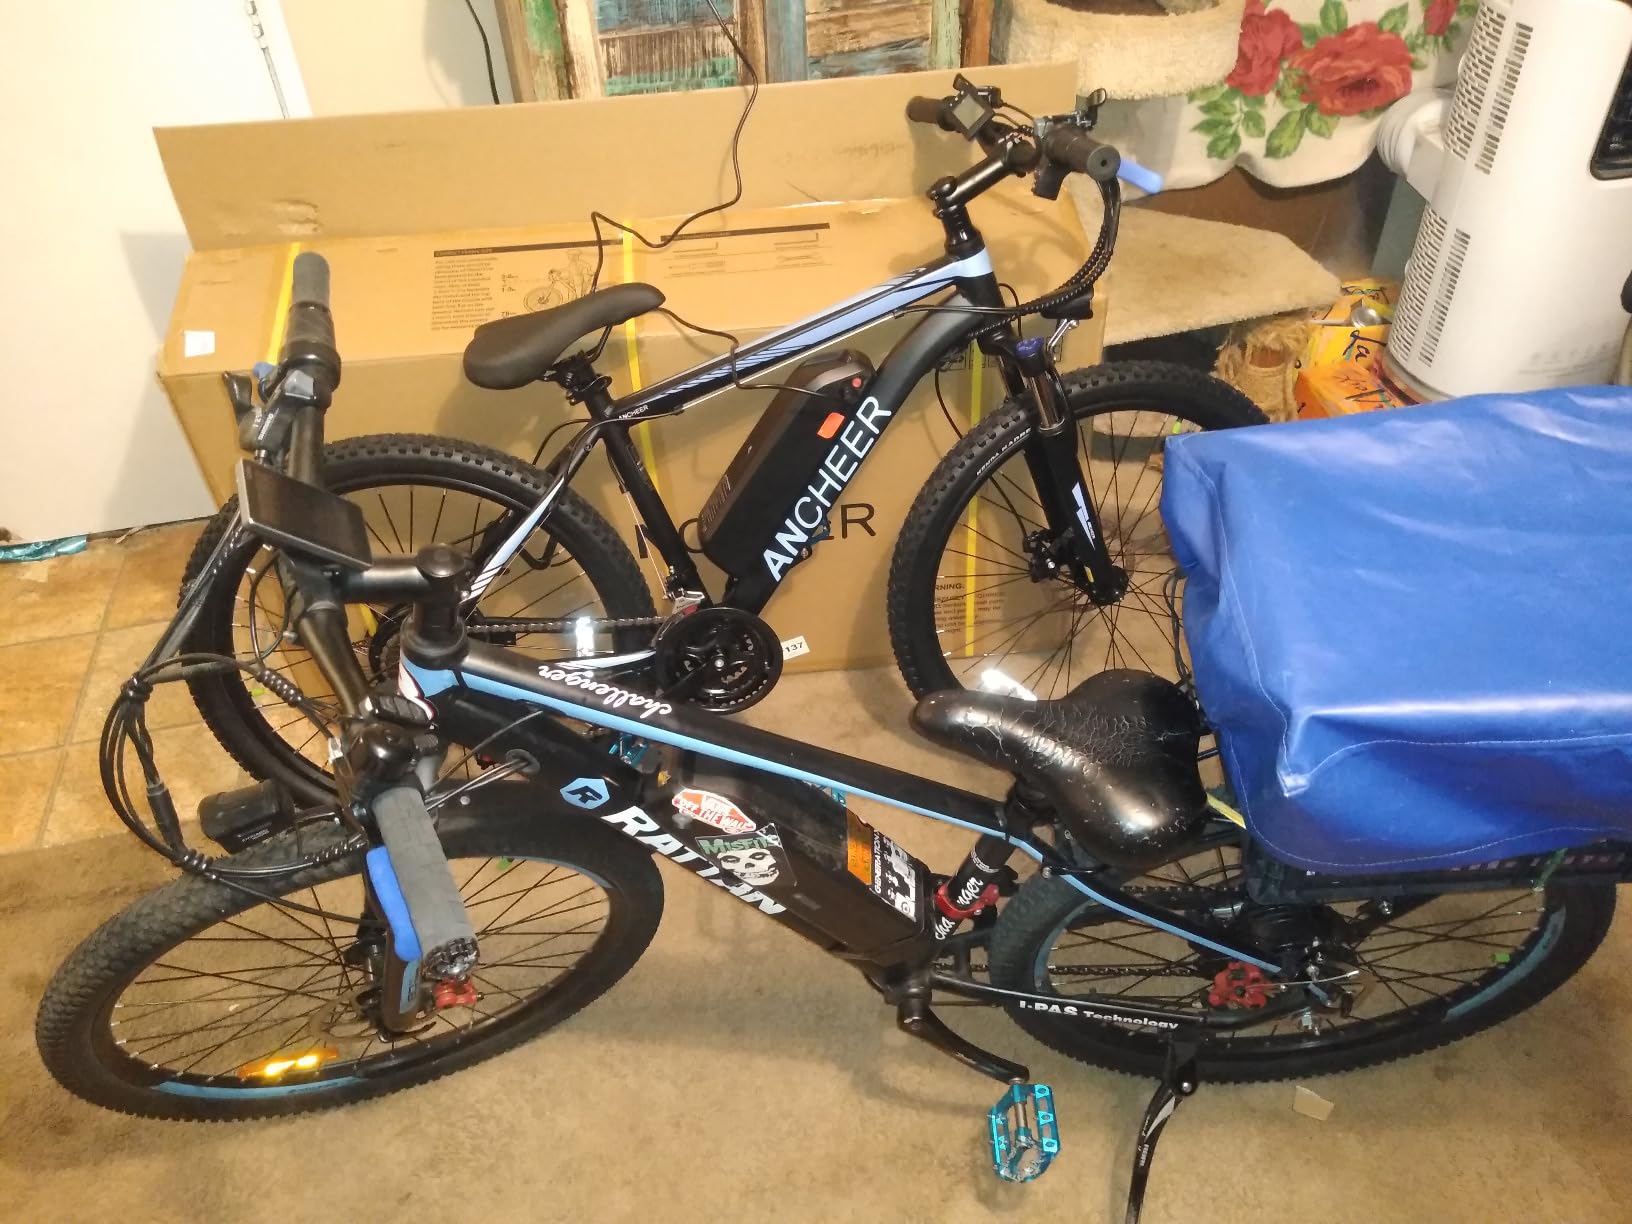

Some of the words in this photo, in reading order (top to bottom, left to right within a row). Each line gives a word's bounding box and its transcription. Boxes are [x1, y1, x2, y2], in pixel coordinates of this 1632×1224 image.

[618, 404, 649, 420] ANCHEER
[763, 396, 892, 583] ANCHEER
[784, 641, 804, 653] 137
[537, 665, 673, 719] challenger
[699, 807, 721, 824] THE
[1019, 1000, 1079, 1016] I-PAS
[1083, 1010, 1179, 1030] Technology
